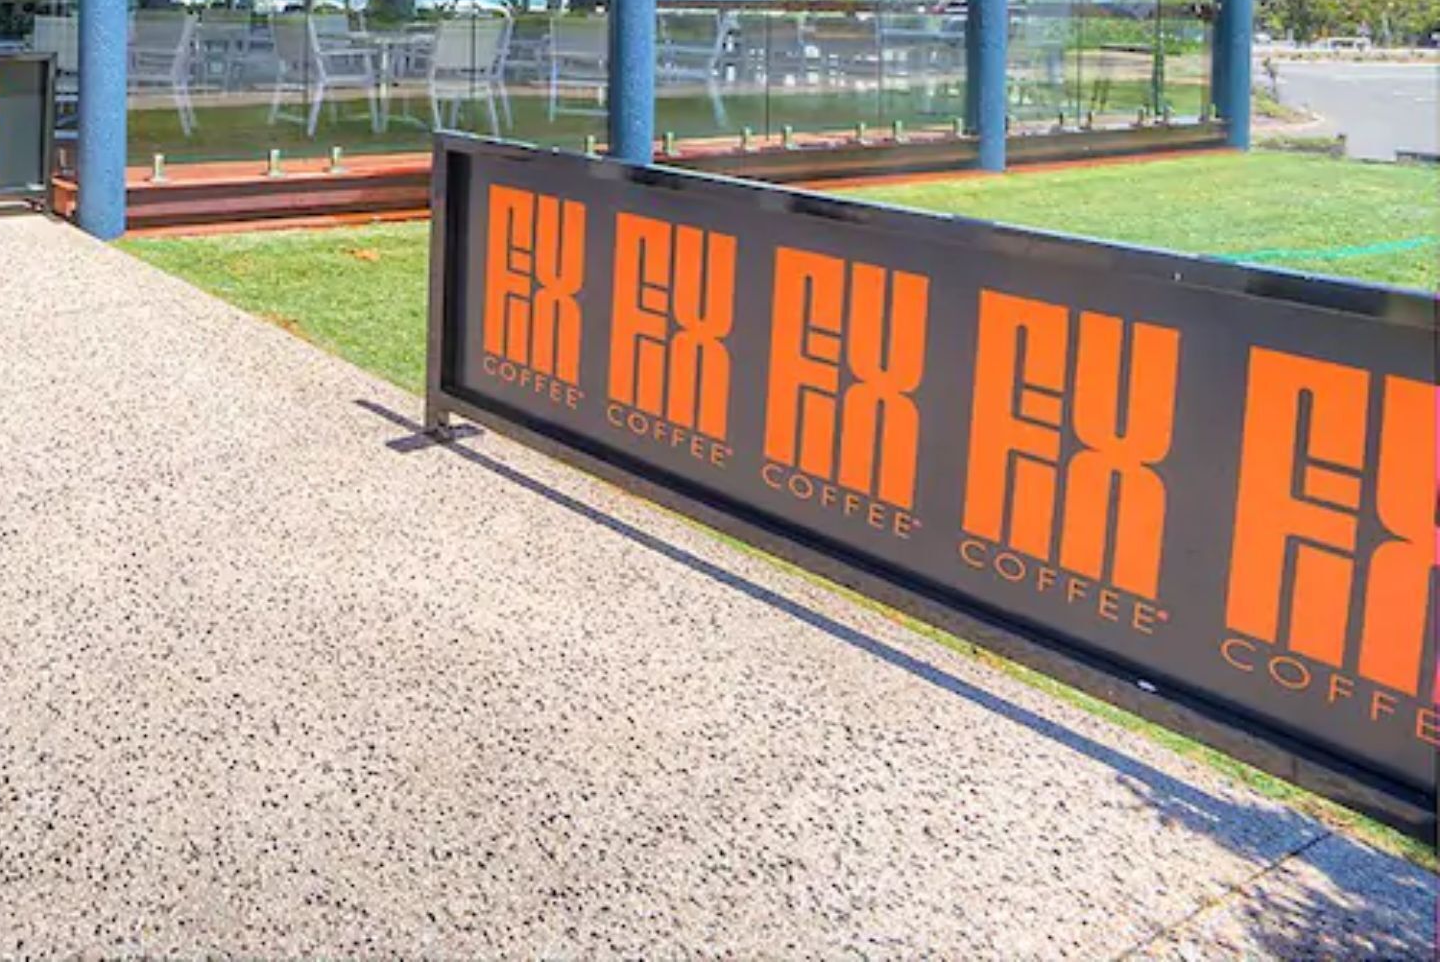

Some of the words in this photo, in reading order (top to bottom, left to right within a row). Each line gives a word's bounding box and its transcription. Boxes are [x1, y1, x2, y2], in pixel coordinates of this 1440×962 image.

[482, 355, 580, 410] COFFEE
[606, 400, 728, 467] COFFEE
[761, 461, 914, 540] COFFEE
[959, 539, 1157, 635] COFFEE
